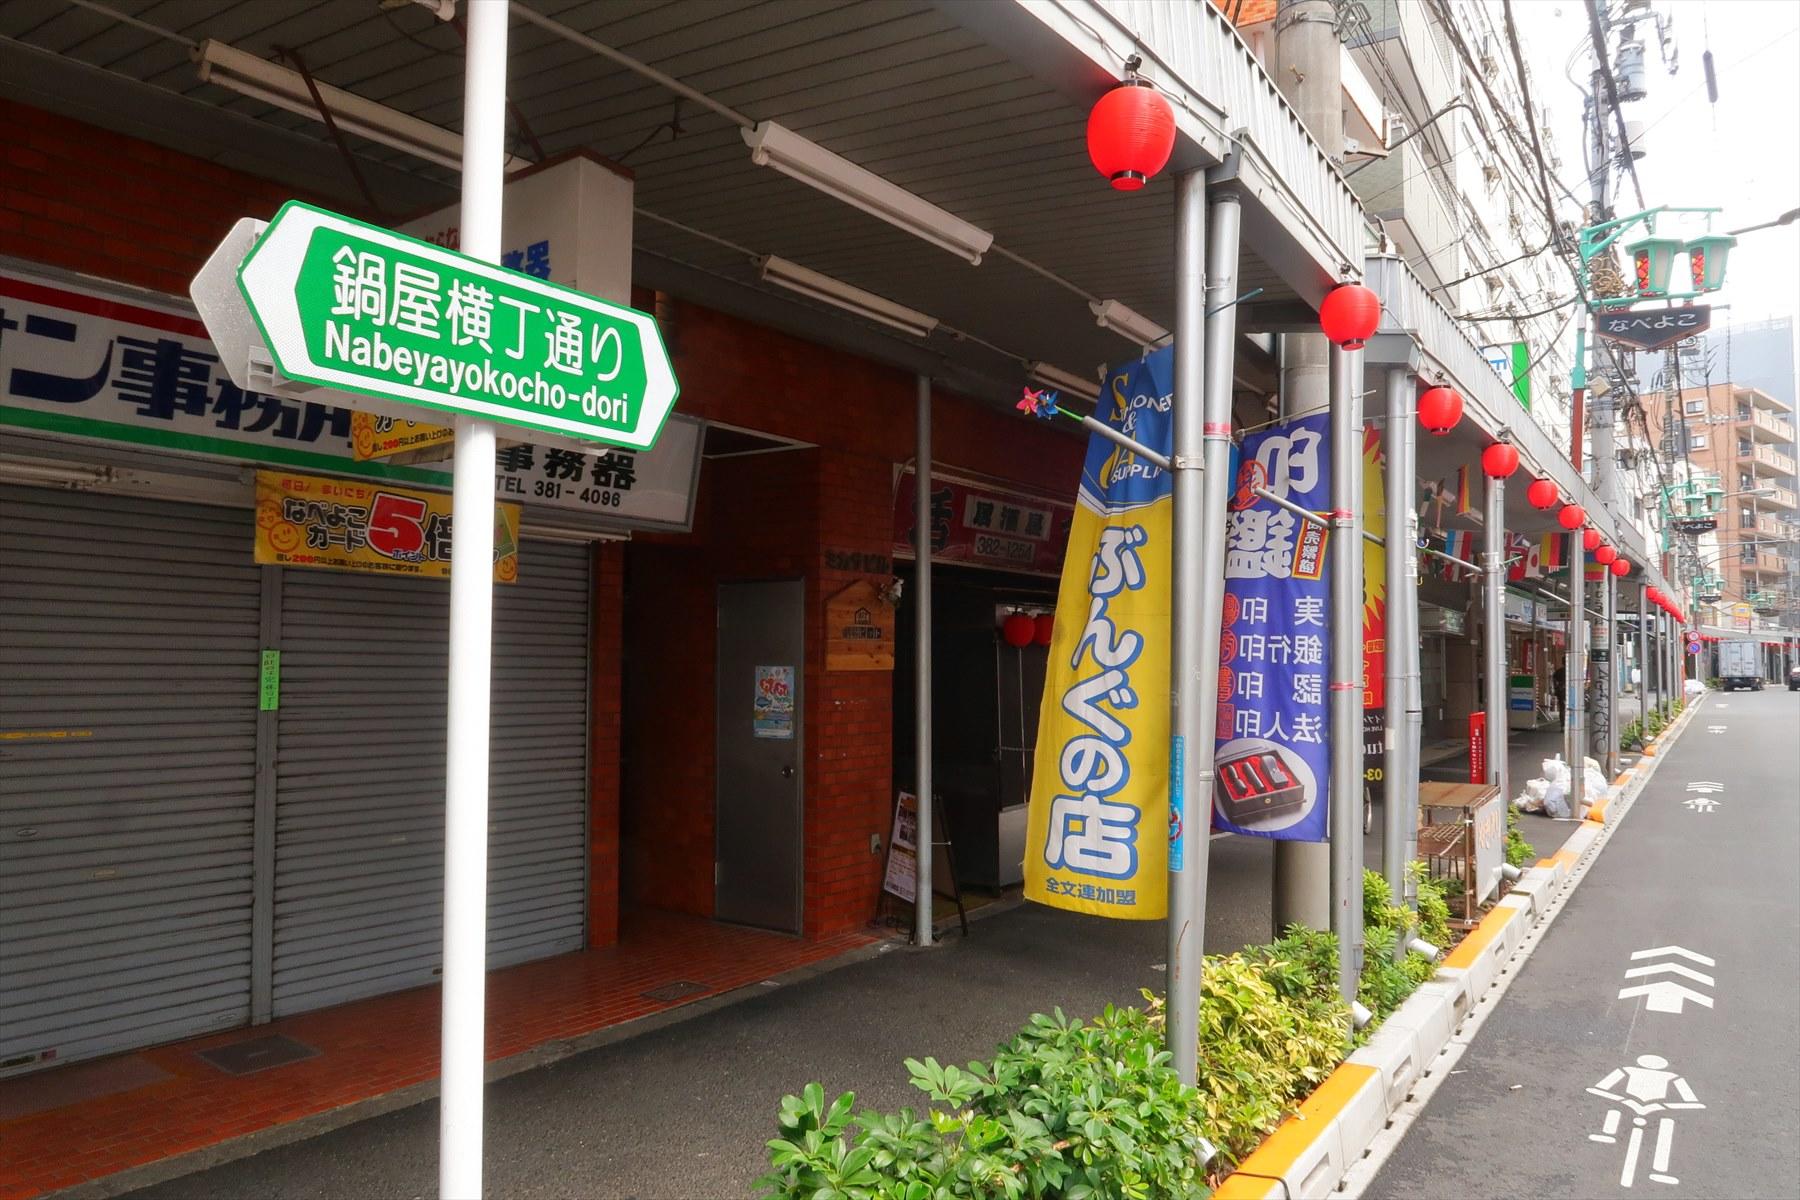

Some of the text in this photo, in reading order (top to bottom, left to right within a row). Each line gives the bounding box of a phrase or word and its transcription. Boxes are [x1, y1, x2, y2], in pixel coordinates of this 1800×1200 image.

[330, 244, 624, 382] 鍋屋横丁通り
[1608, 313, 1697, 332] なべよこ
[324, 319, 629, 423] Nabeyayokocho-dori
[496, 445, 637, 490] 事務器
[495, 474, 622, 508] TEL 381-4096
[283, 498, 369, 529] なべよこ
[306, 525, 368, 553] カード
[1045, 527, 1148, 880] ぶんぐの店
[1045, 878, 1137, 905] 全文連加盟
